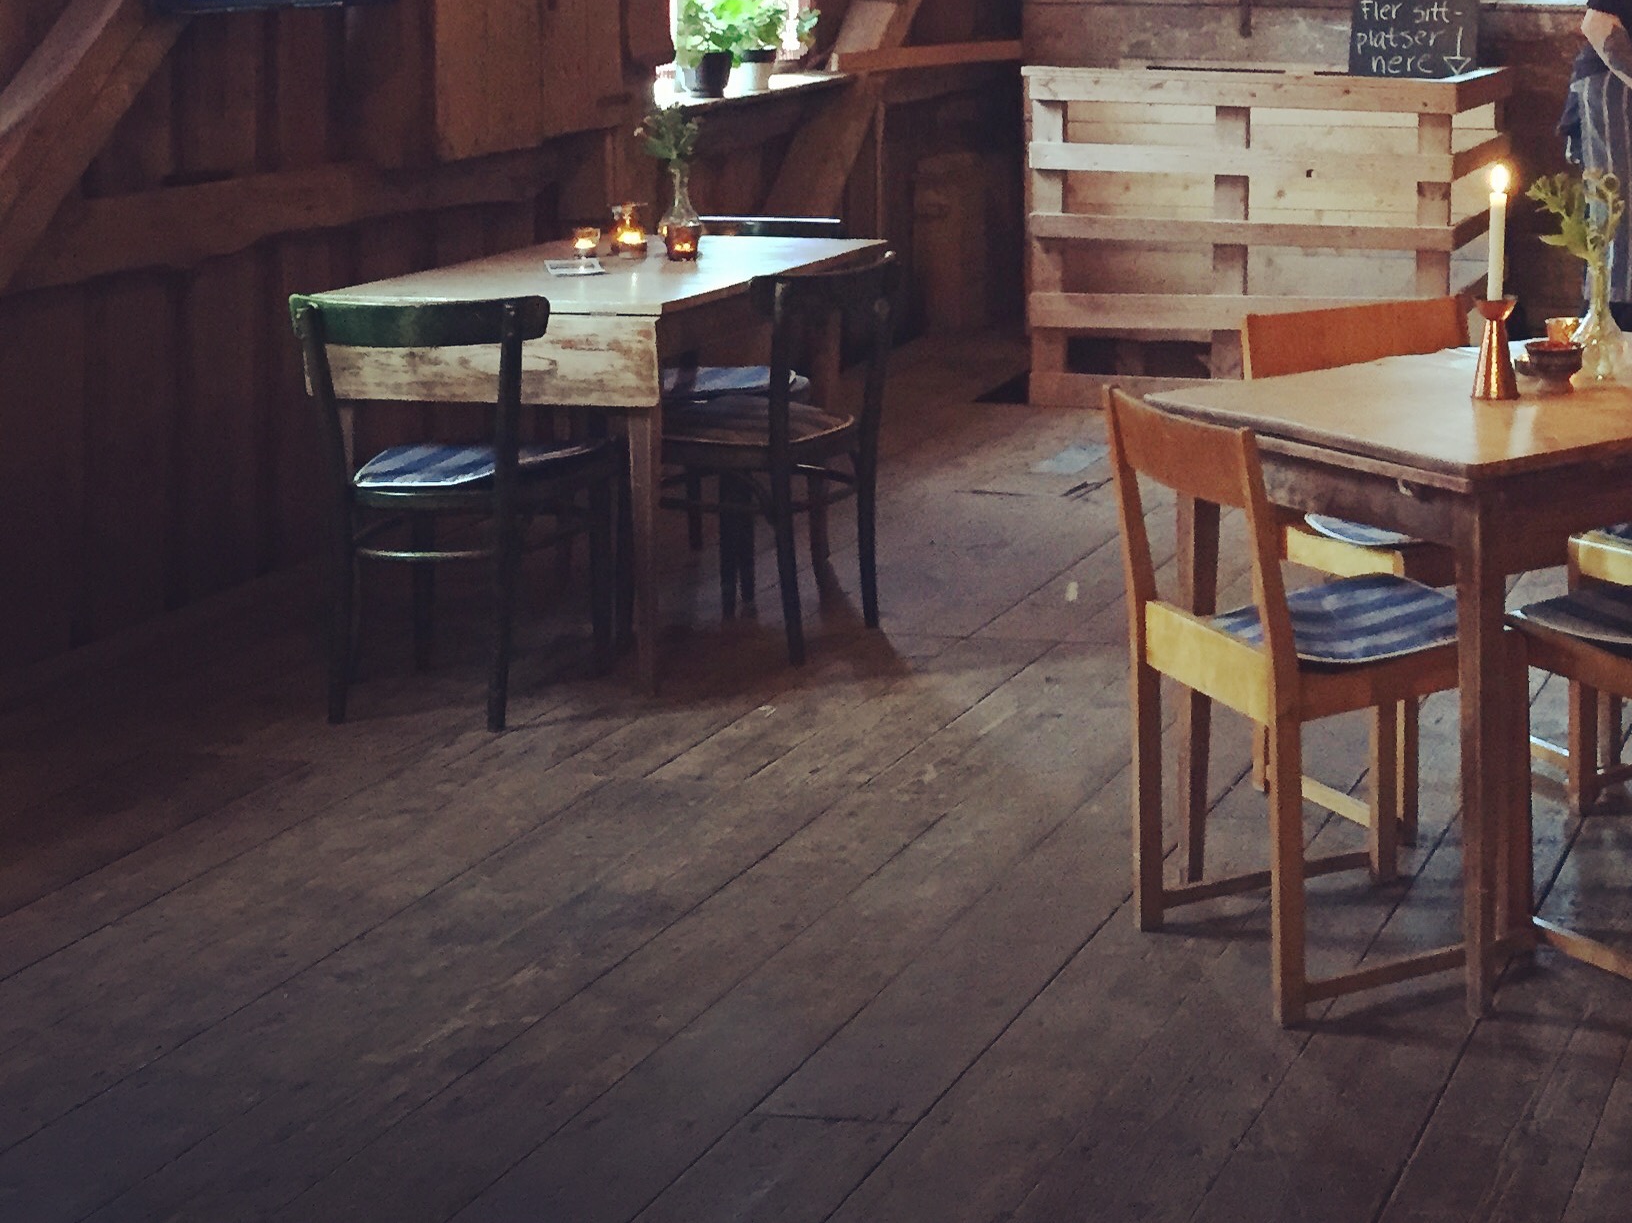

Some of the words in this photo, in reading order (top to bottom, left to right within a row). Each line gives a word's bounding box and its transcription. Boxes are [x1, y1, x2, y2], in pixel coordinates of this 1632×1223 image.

[1360, 0, 1403, 21] Fler
[1356, 26, 1446, 55] platser
[1371, 53, 1434, 75] nere
